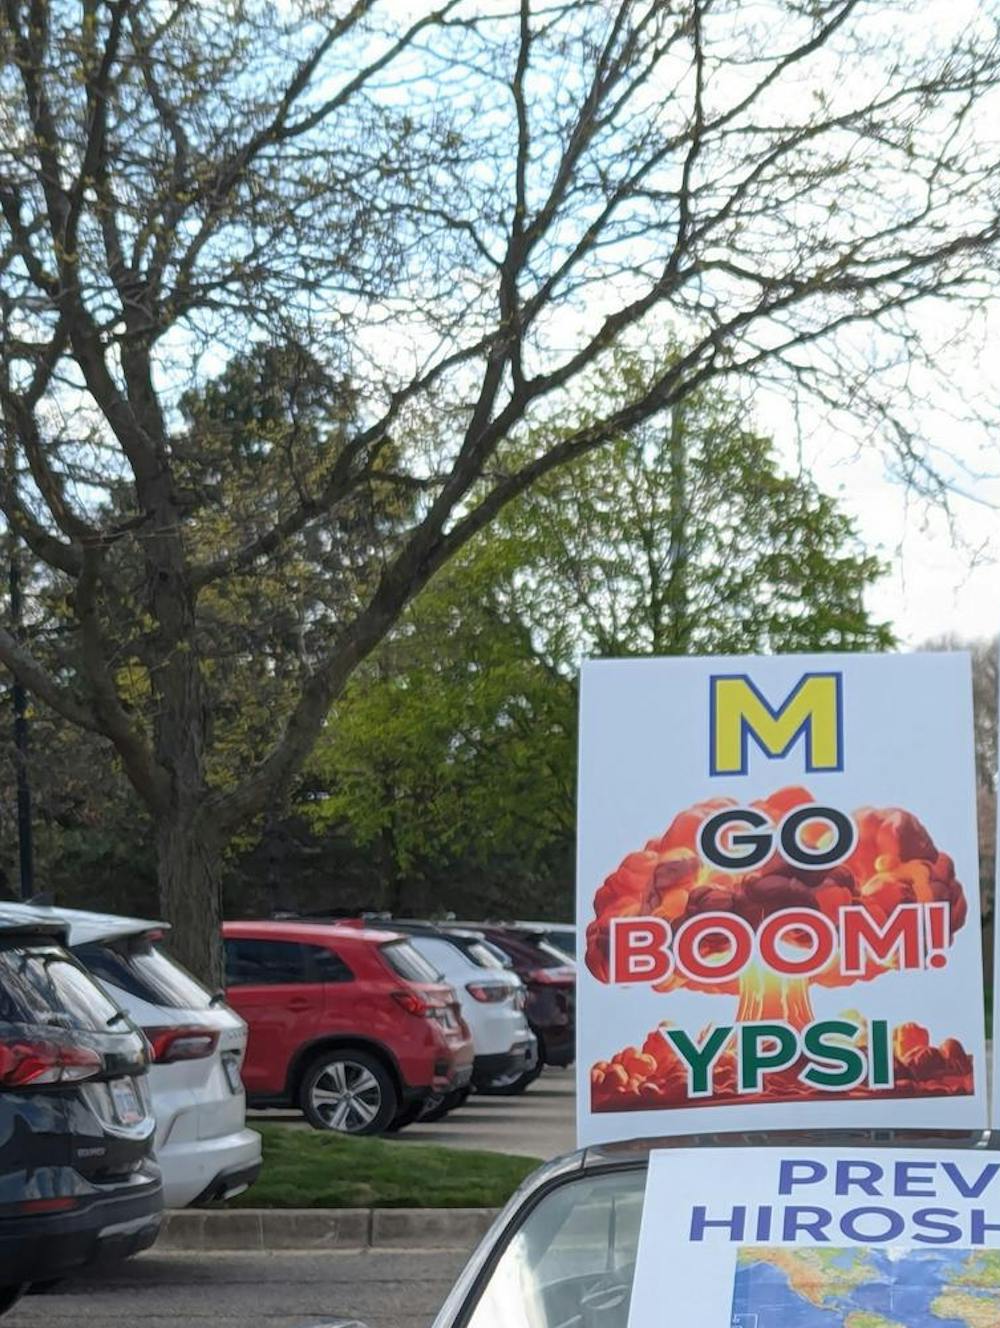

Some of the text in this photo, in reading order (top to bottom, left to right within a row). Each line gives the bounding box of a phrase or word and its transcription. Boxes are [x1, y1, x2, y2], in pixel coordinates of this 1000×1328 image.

[709, 671, 844, 777] M
[700, 805, 856, 871] GO
[609, 901, 951, 985] BOOM!
[664, 1019, 896, 1099] YPSI
